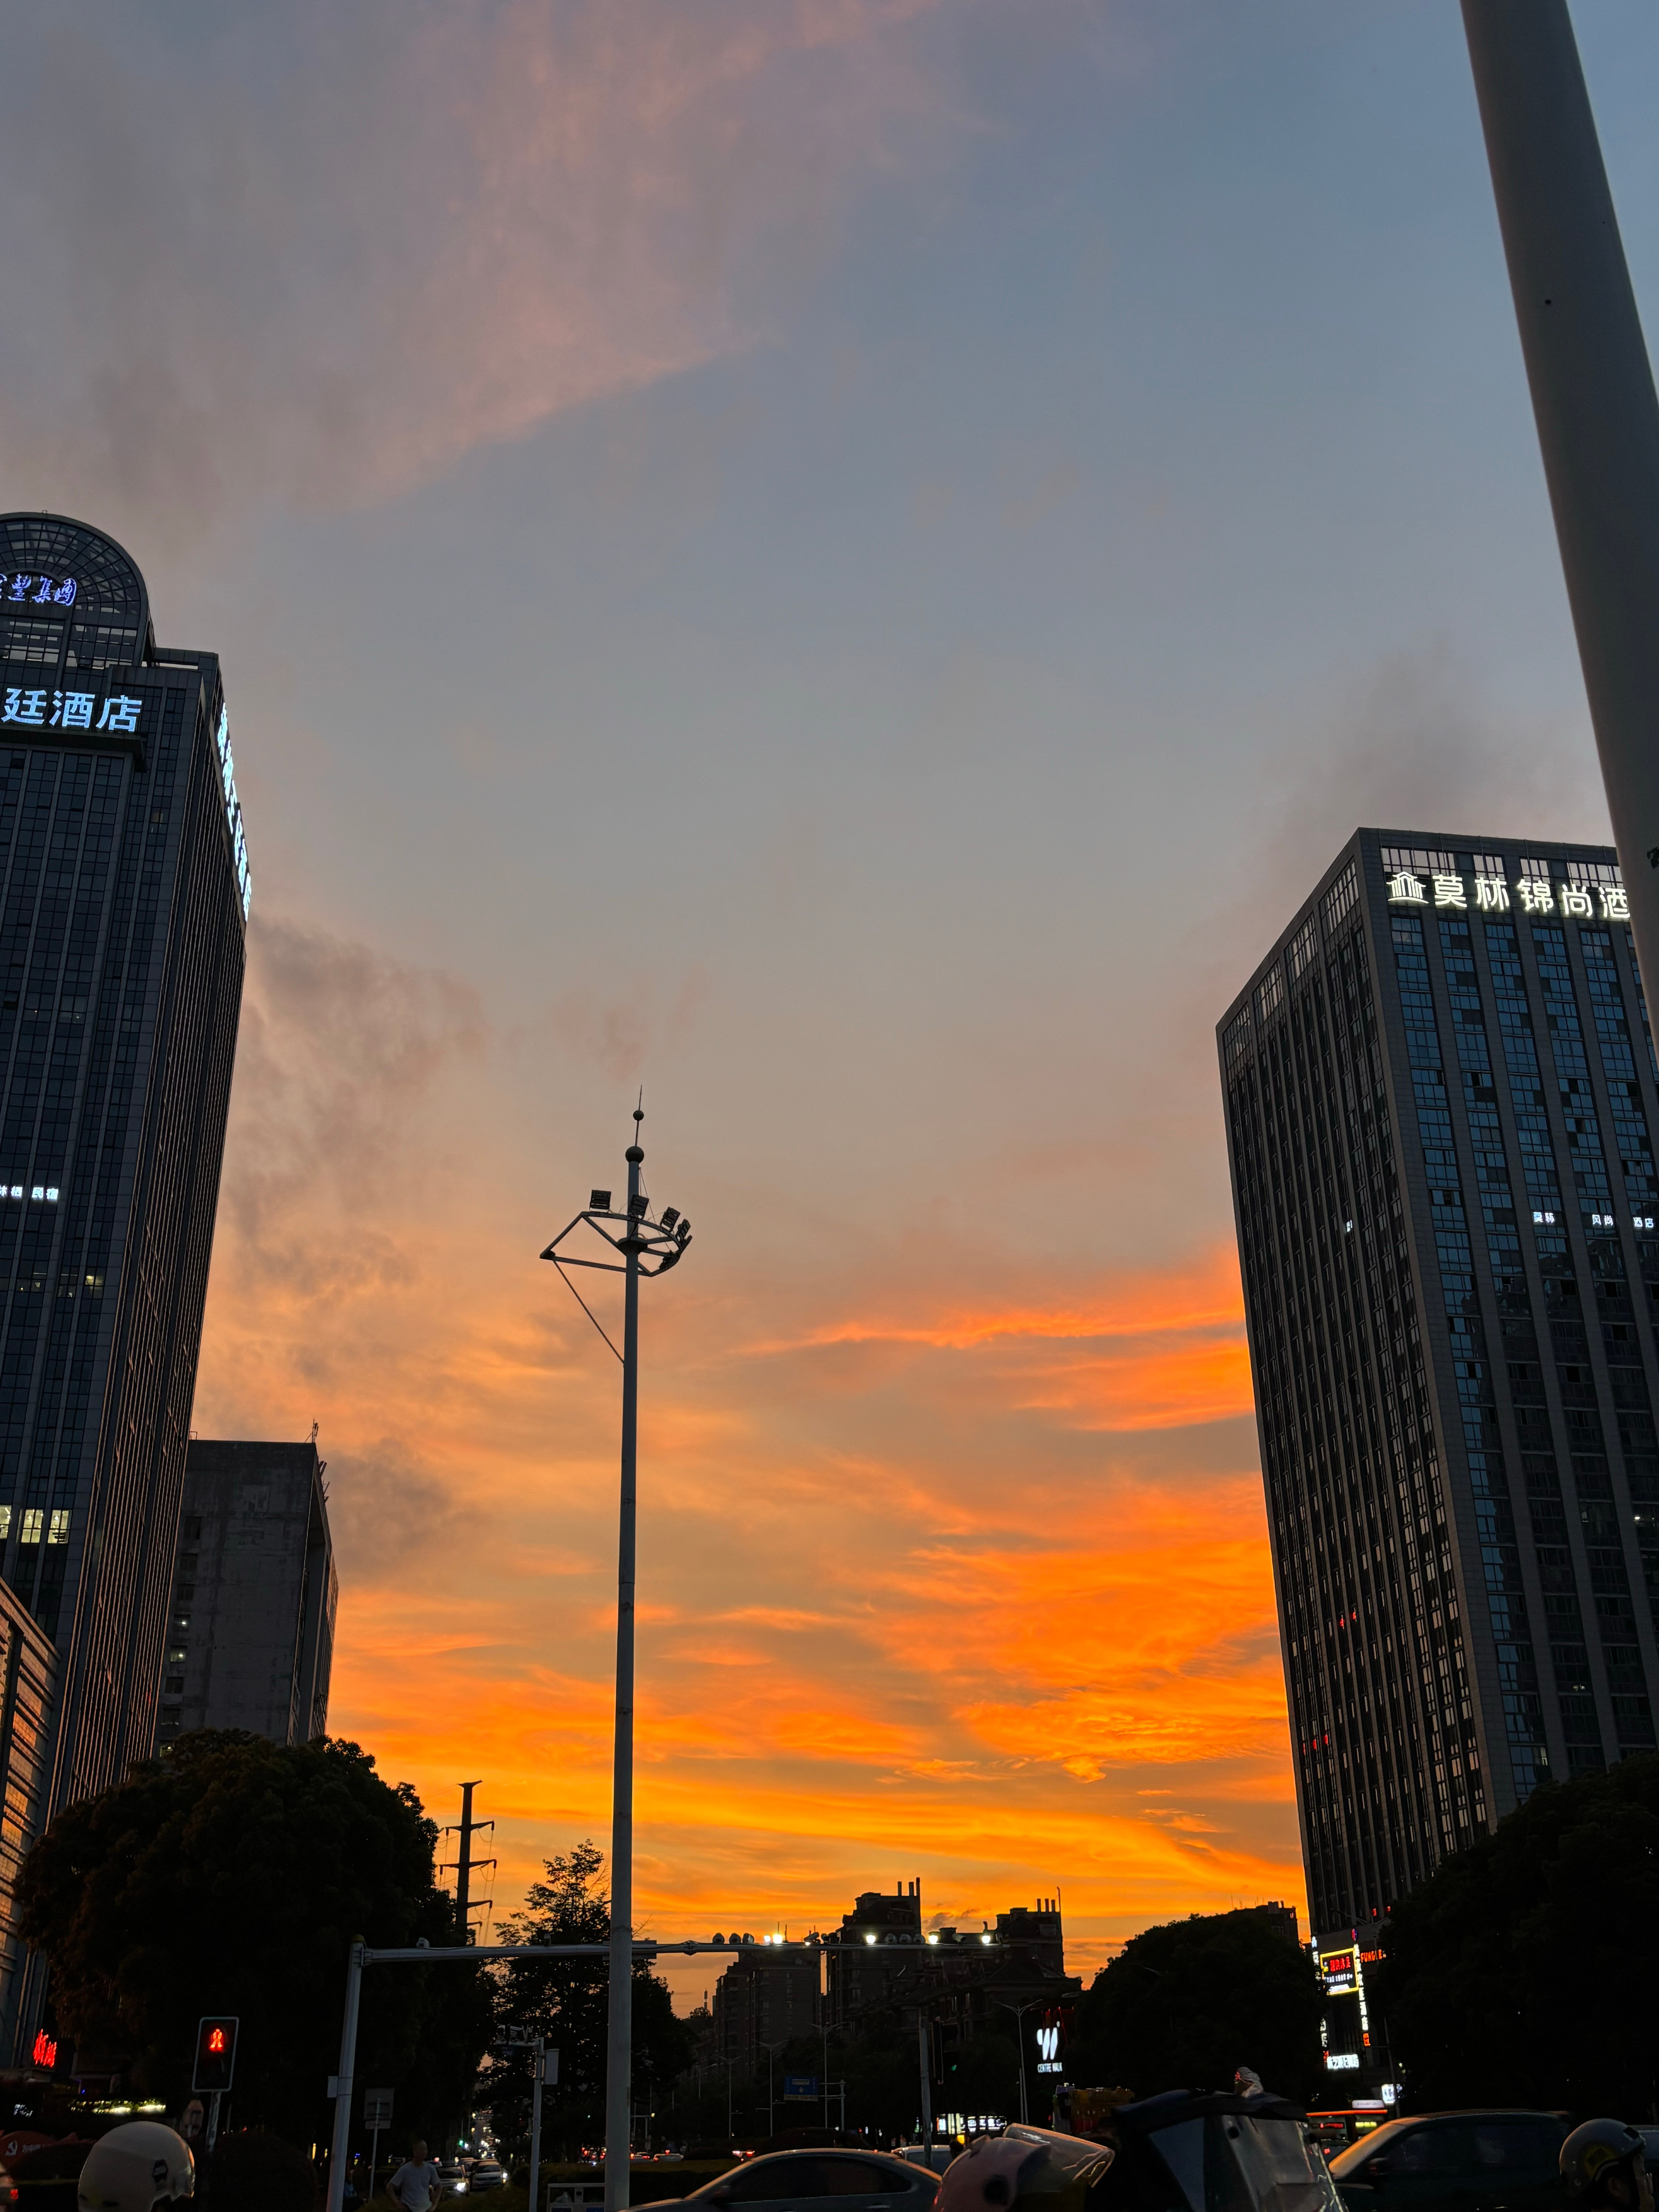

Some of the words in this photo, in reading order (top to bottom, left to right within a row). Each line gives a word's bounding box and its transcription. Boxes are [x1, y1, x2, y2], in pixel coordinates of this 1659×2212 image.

[0, 574, 77, 606] 豐集團
[1, 688, 142, 732] 廷酒店
[1432, 874, 1630, 919] 莫林锦尚酒
